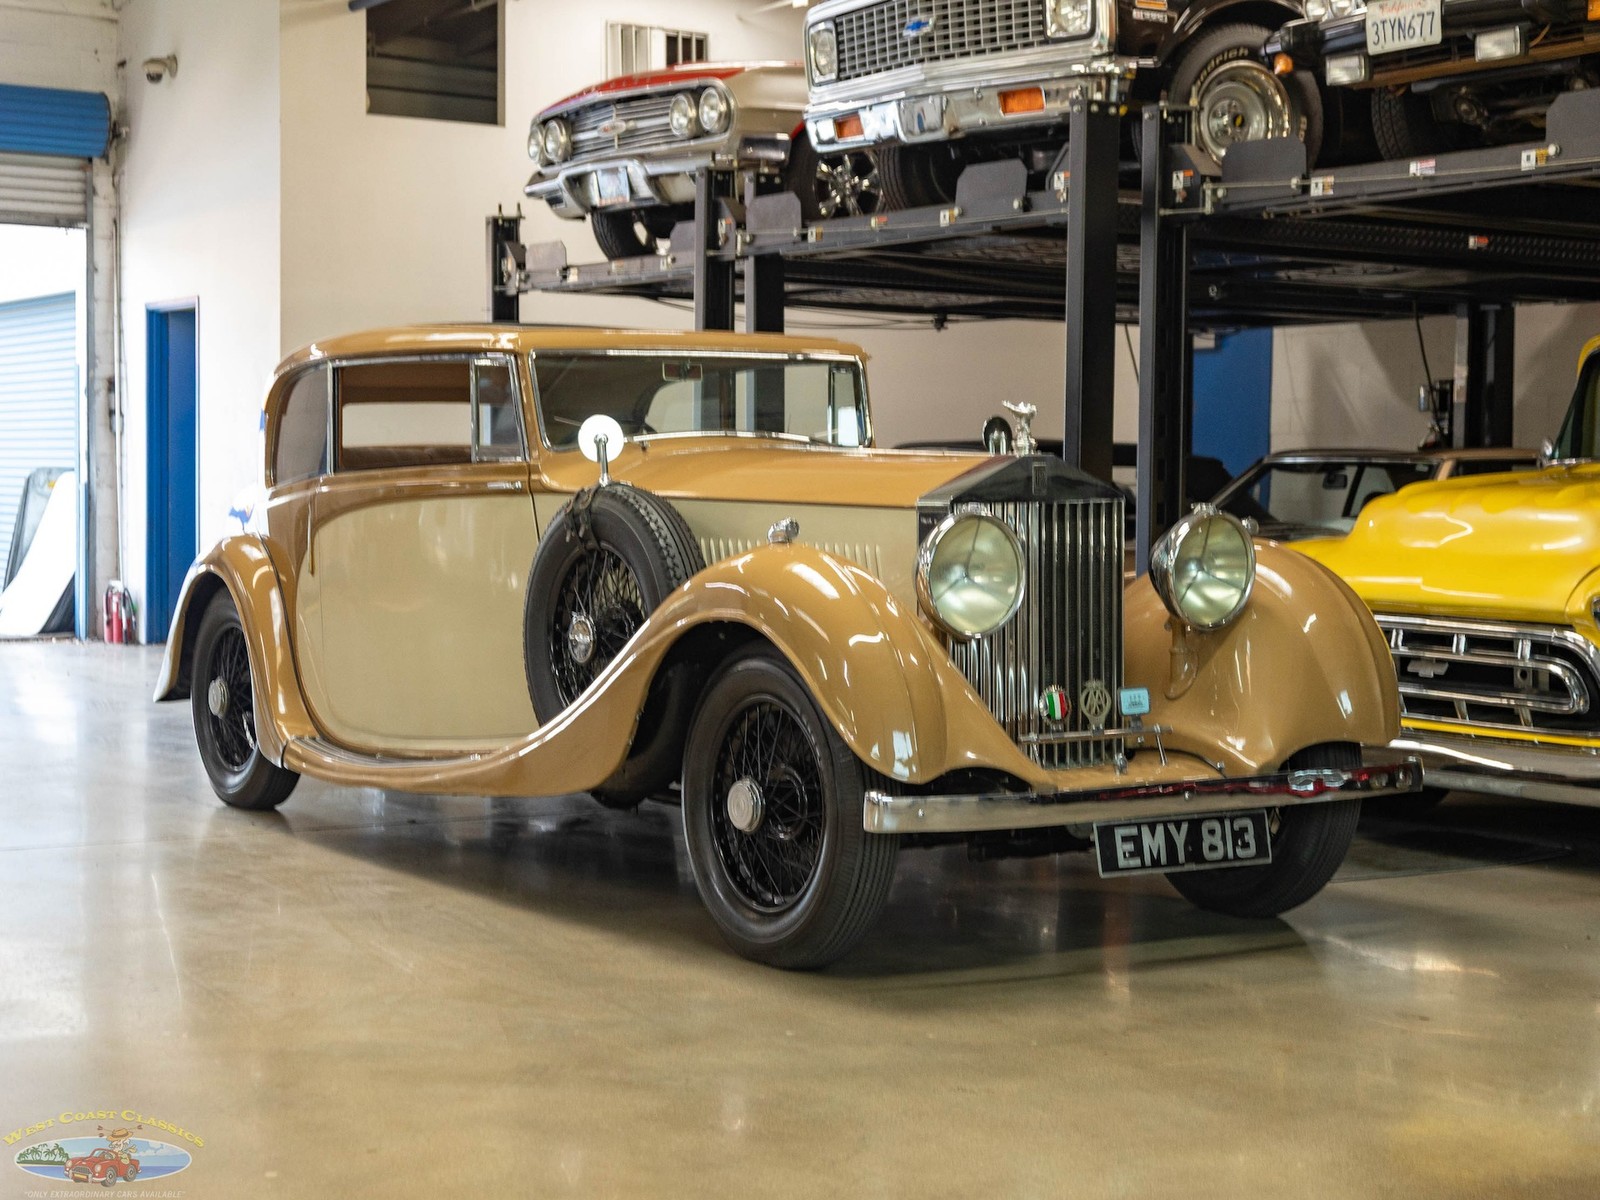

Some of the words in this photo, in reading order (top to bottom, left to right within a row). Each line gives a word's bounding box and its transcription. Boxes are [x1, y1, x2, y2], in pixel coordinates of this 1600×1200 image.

[1371, 11, 1435, 46] 3TYN677
[1114, 820, 1189, 869] EMY
[1201, 816, 1257, 862] 813
